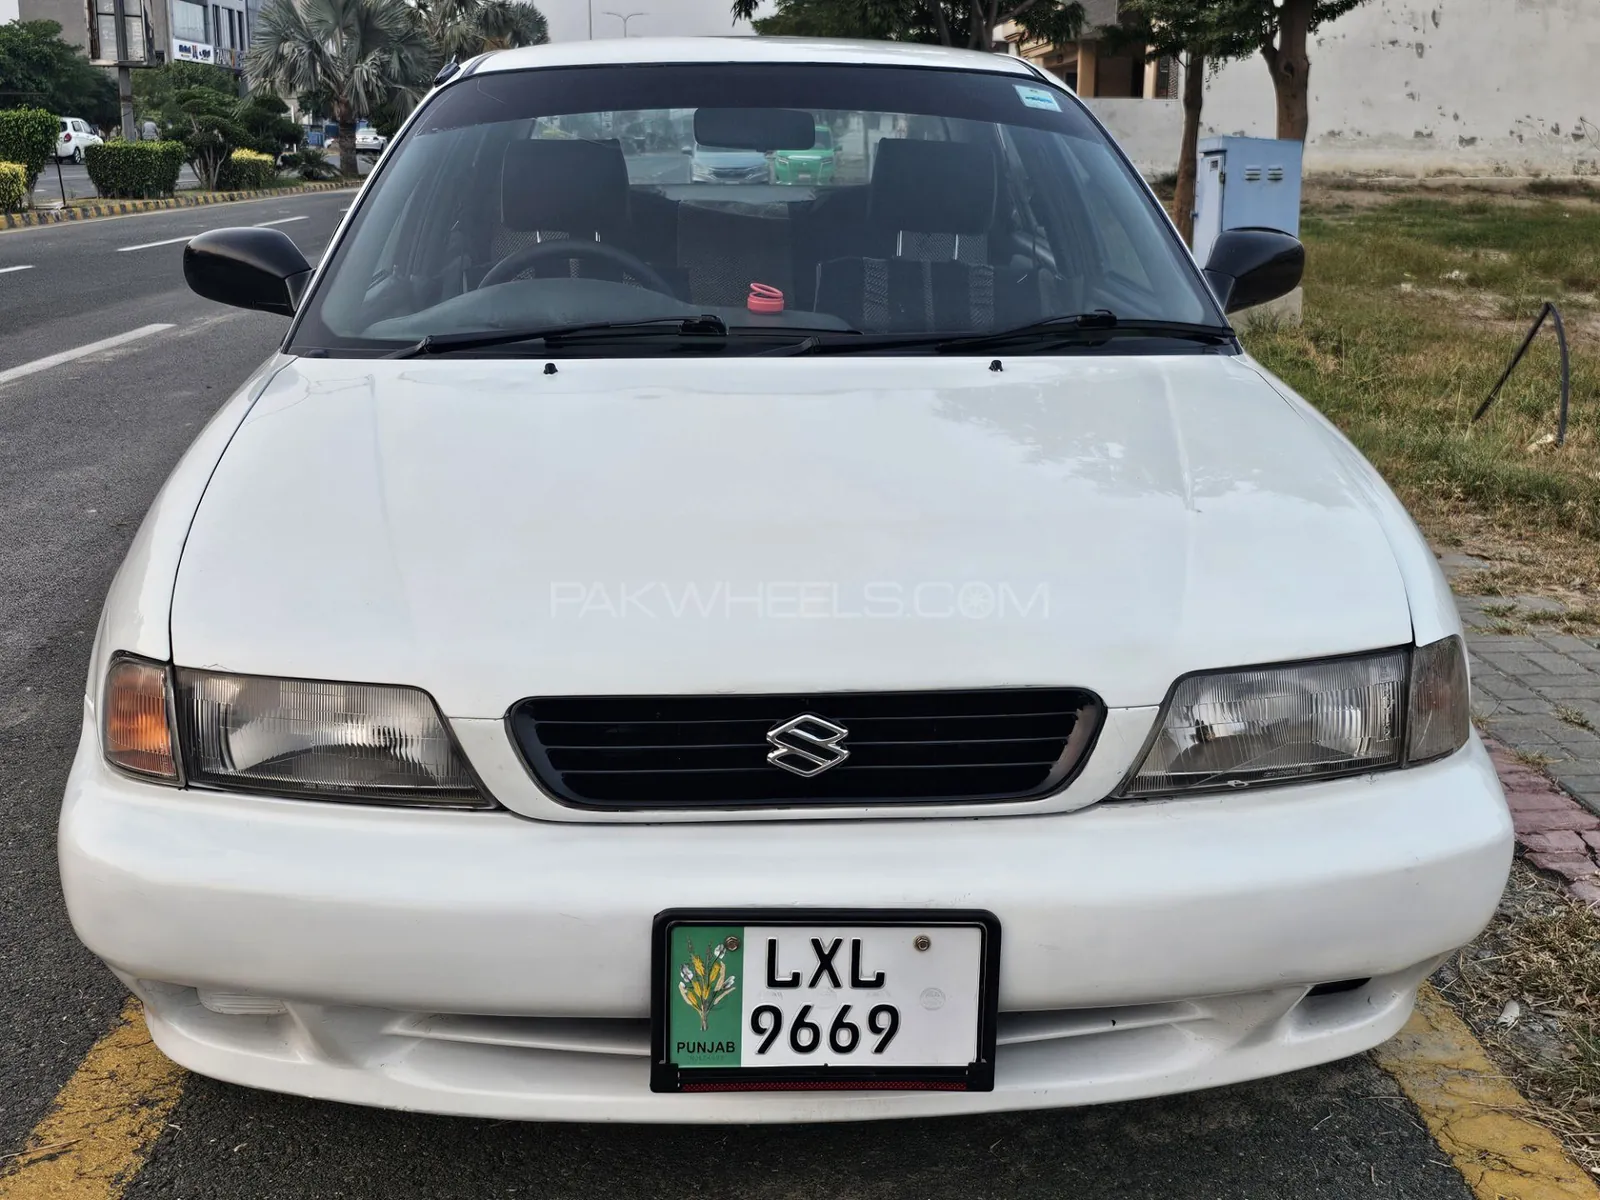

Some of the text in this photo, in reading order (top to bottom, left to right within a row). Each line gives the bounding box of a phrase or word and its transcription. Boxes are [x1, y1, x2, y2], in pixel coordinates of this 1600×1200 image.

[766, 937, 885, 988] LXL
[676, 1041, 736, 1054] PUNJAB
[750, 1004, 900, 1054] 9669
